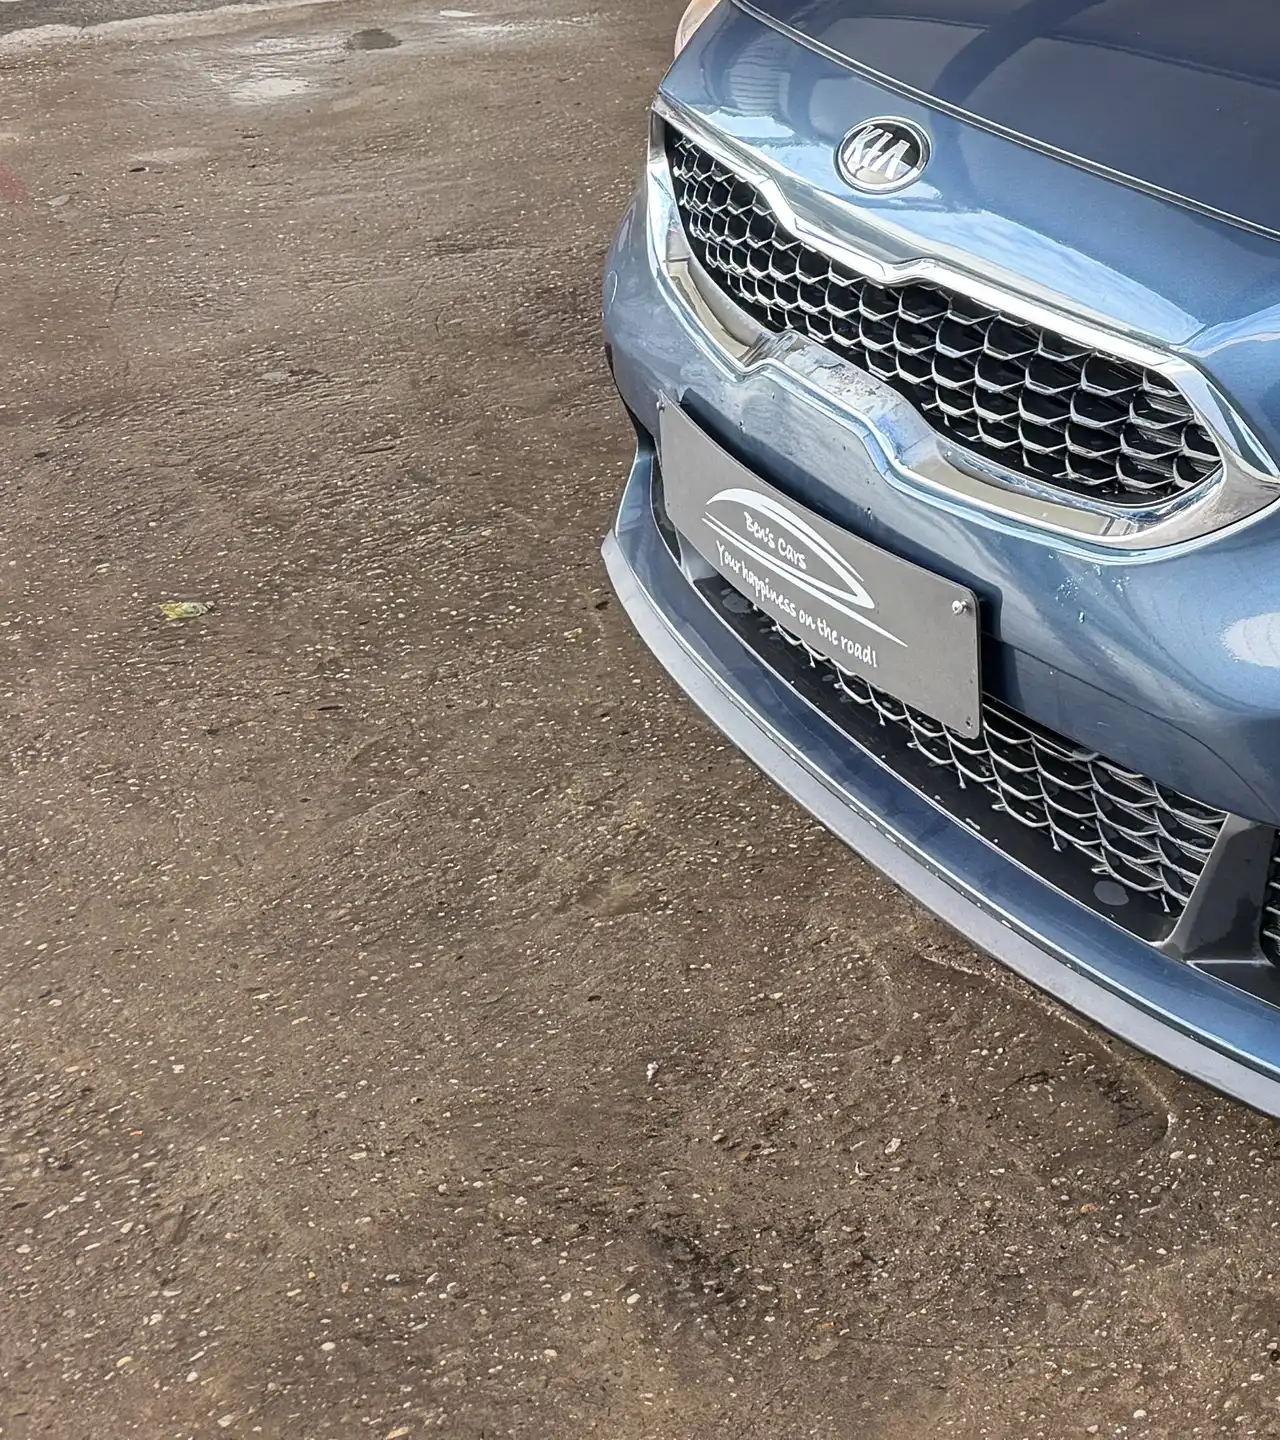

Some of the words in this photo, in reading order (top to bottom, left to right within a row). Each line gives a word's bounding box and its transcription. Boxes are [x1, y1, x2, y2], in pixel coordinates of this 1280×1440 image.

[743, 511, 776, 549] Ben's
[777, 537, 807, 570] Cars
[715, 539, 742, 574] Your
[741, 560, 797, 618] happiness
[798, 609, 816, 631] on
[816, 617, 839, 646] the
[840, 635, 878, 669] road!
